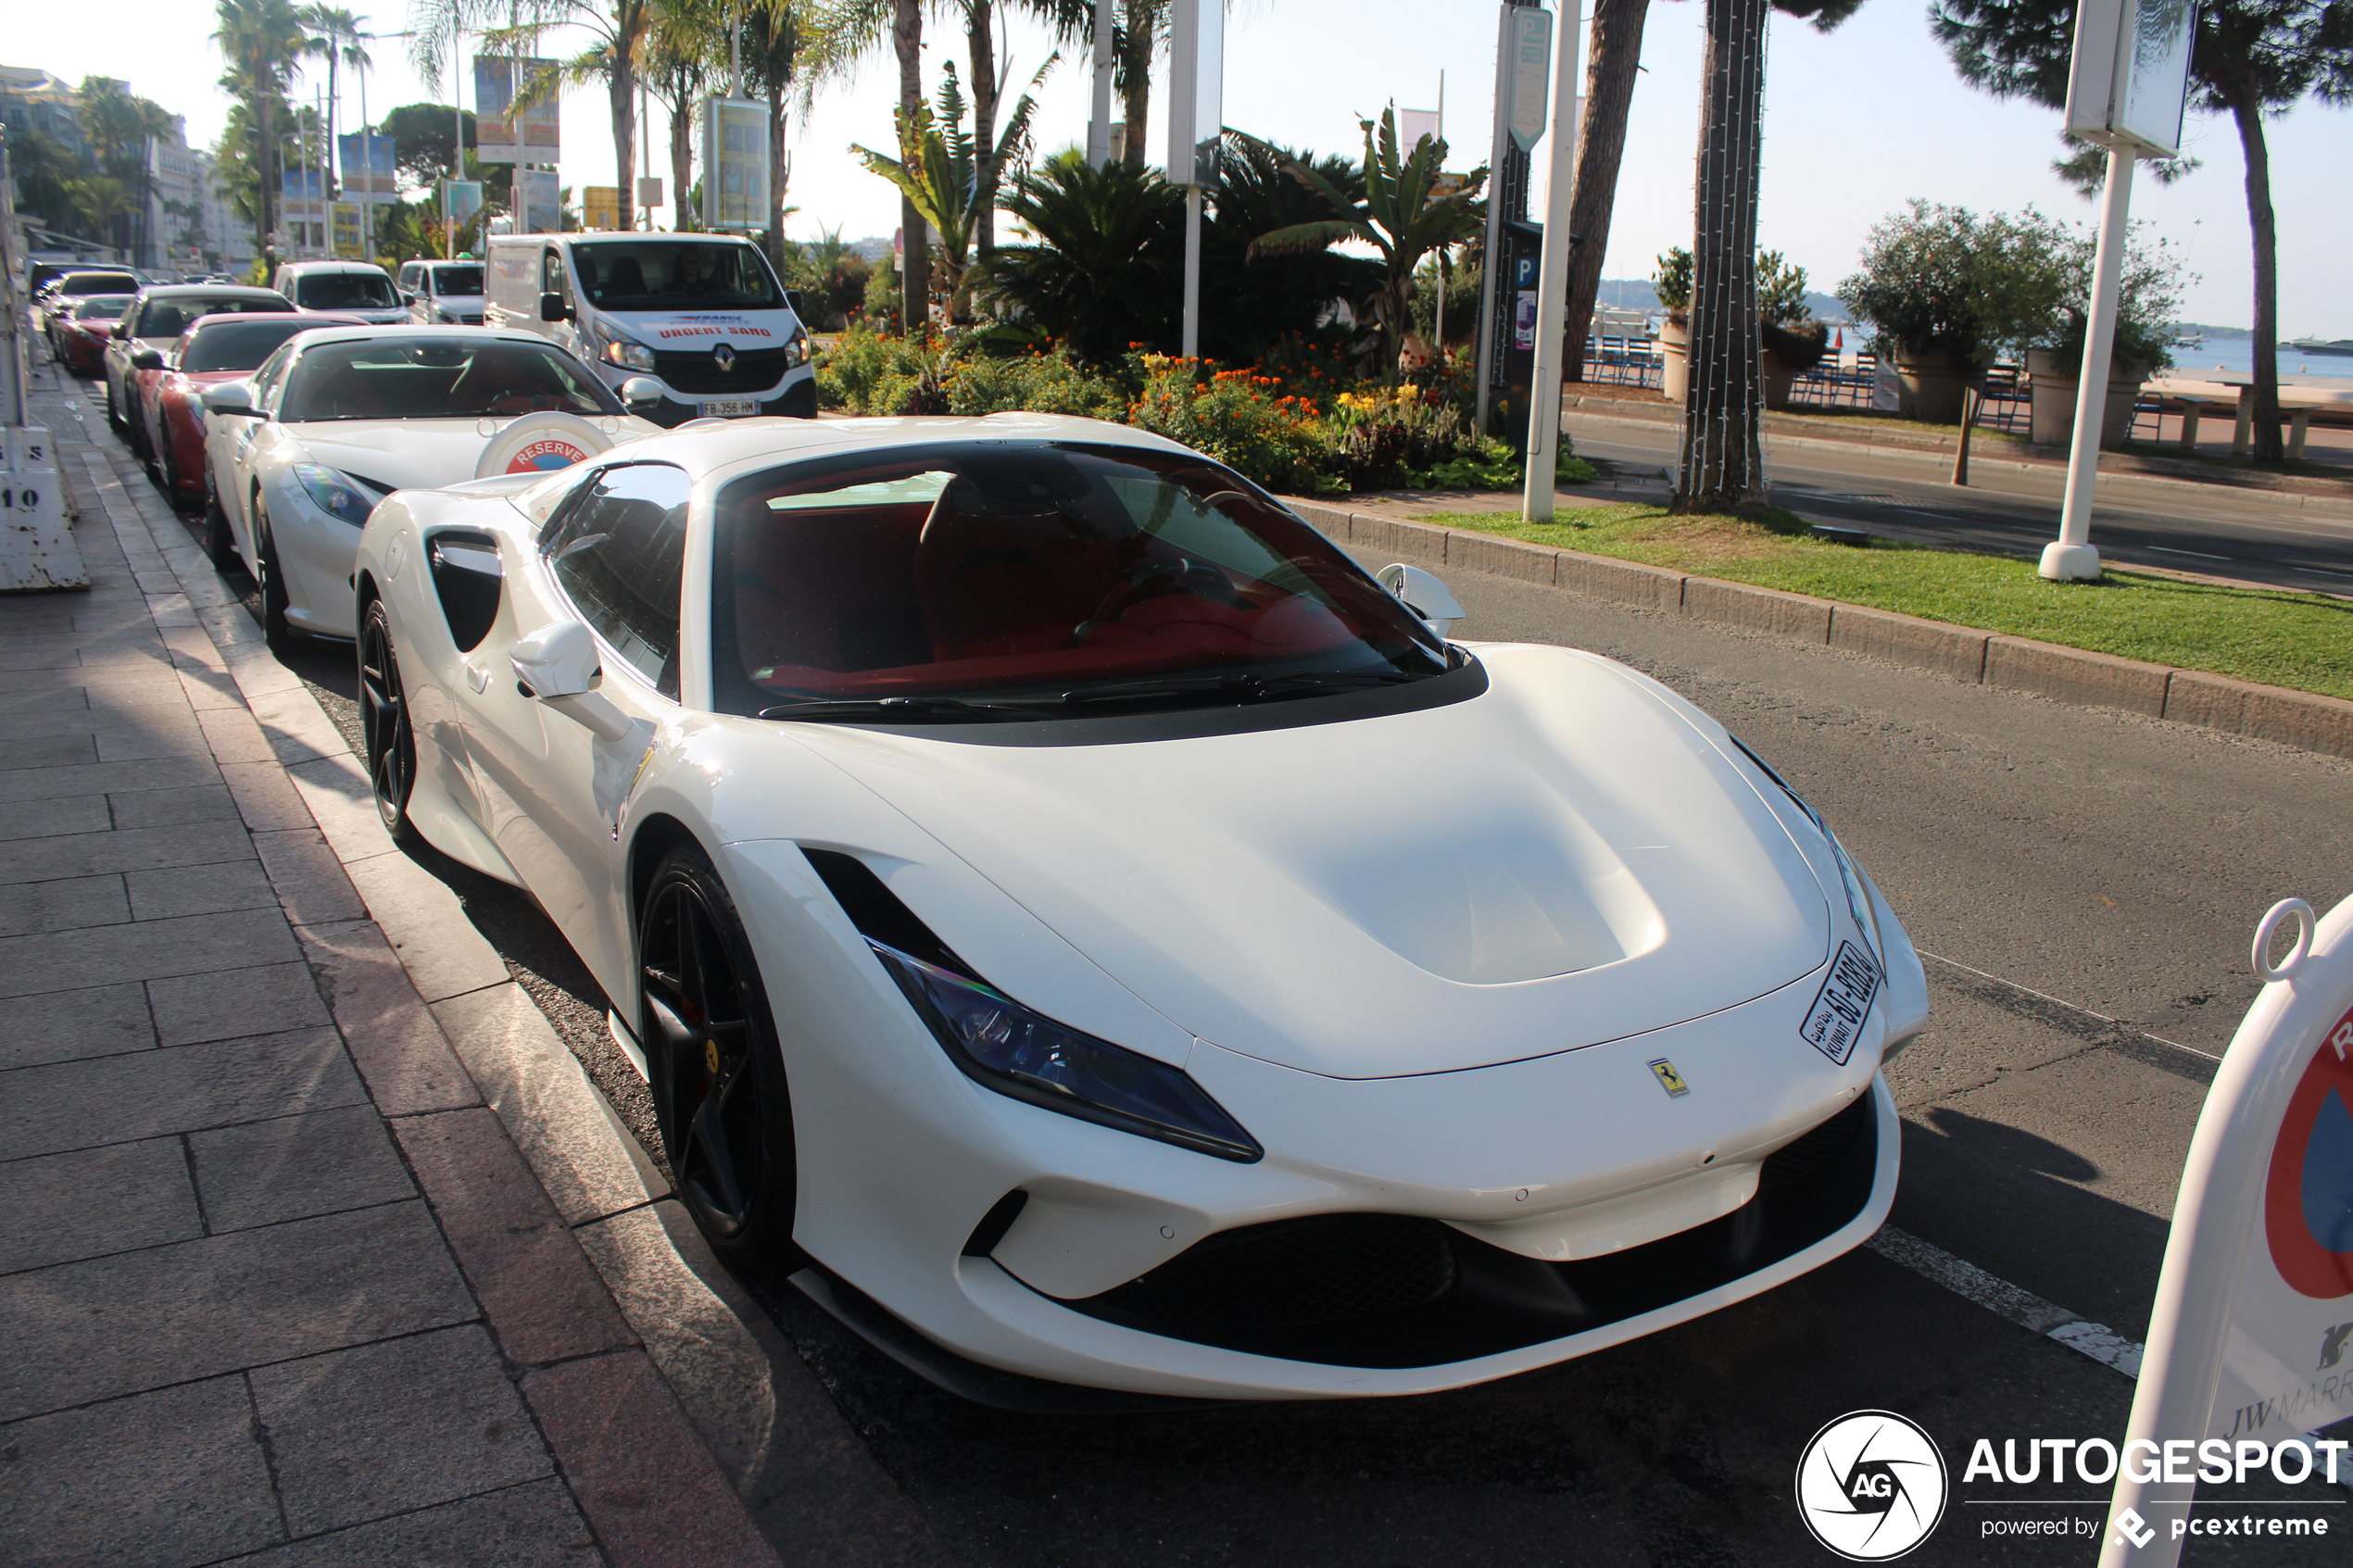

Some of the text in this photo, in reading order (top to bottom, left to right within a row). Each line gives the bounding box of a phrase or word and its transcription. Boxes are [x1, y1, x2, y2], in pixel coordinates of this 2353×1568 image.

[1519, 259, 1532, 282] P
[659, 327, 772, 339] URGENT SANG
[516, 442, 583, 465] RESERVE
[2, 489, 39, 508] 10
[1823, 946, 1879, 1025] 60-81814
[1825, 1021, 1852, 1059] KUWAIT
[2223, 1397, 2276, 1440] JW
